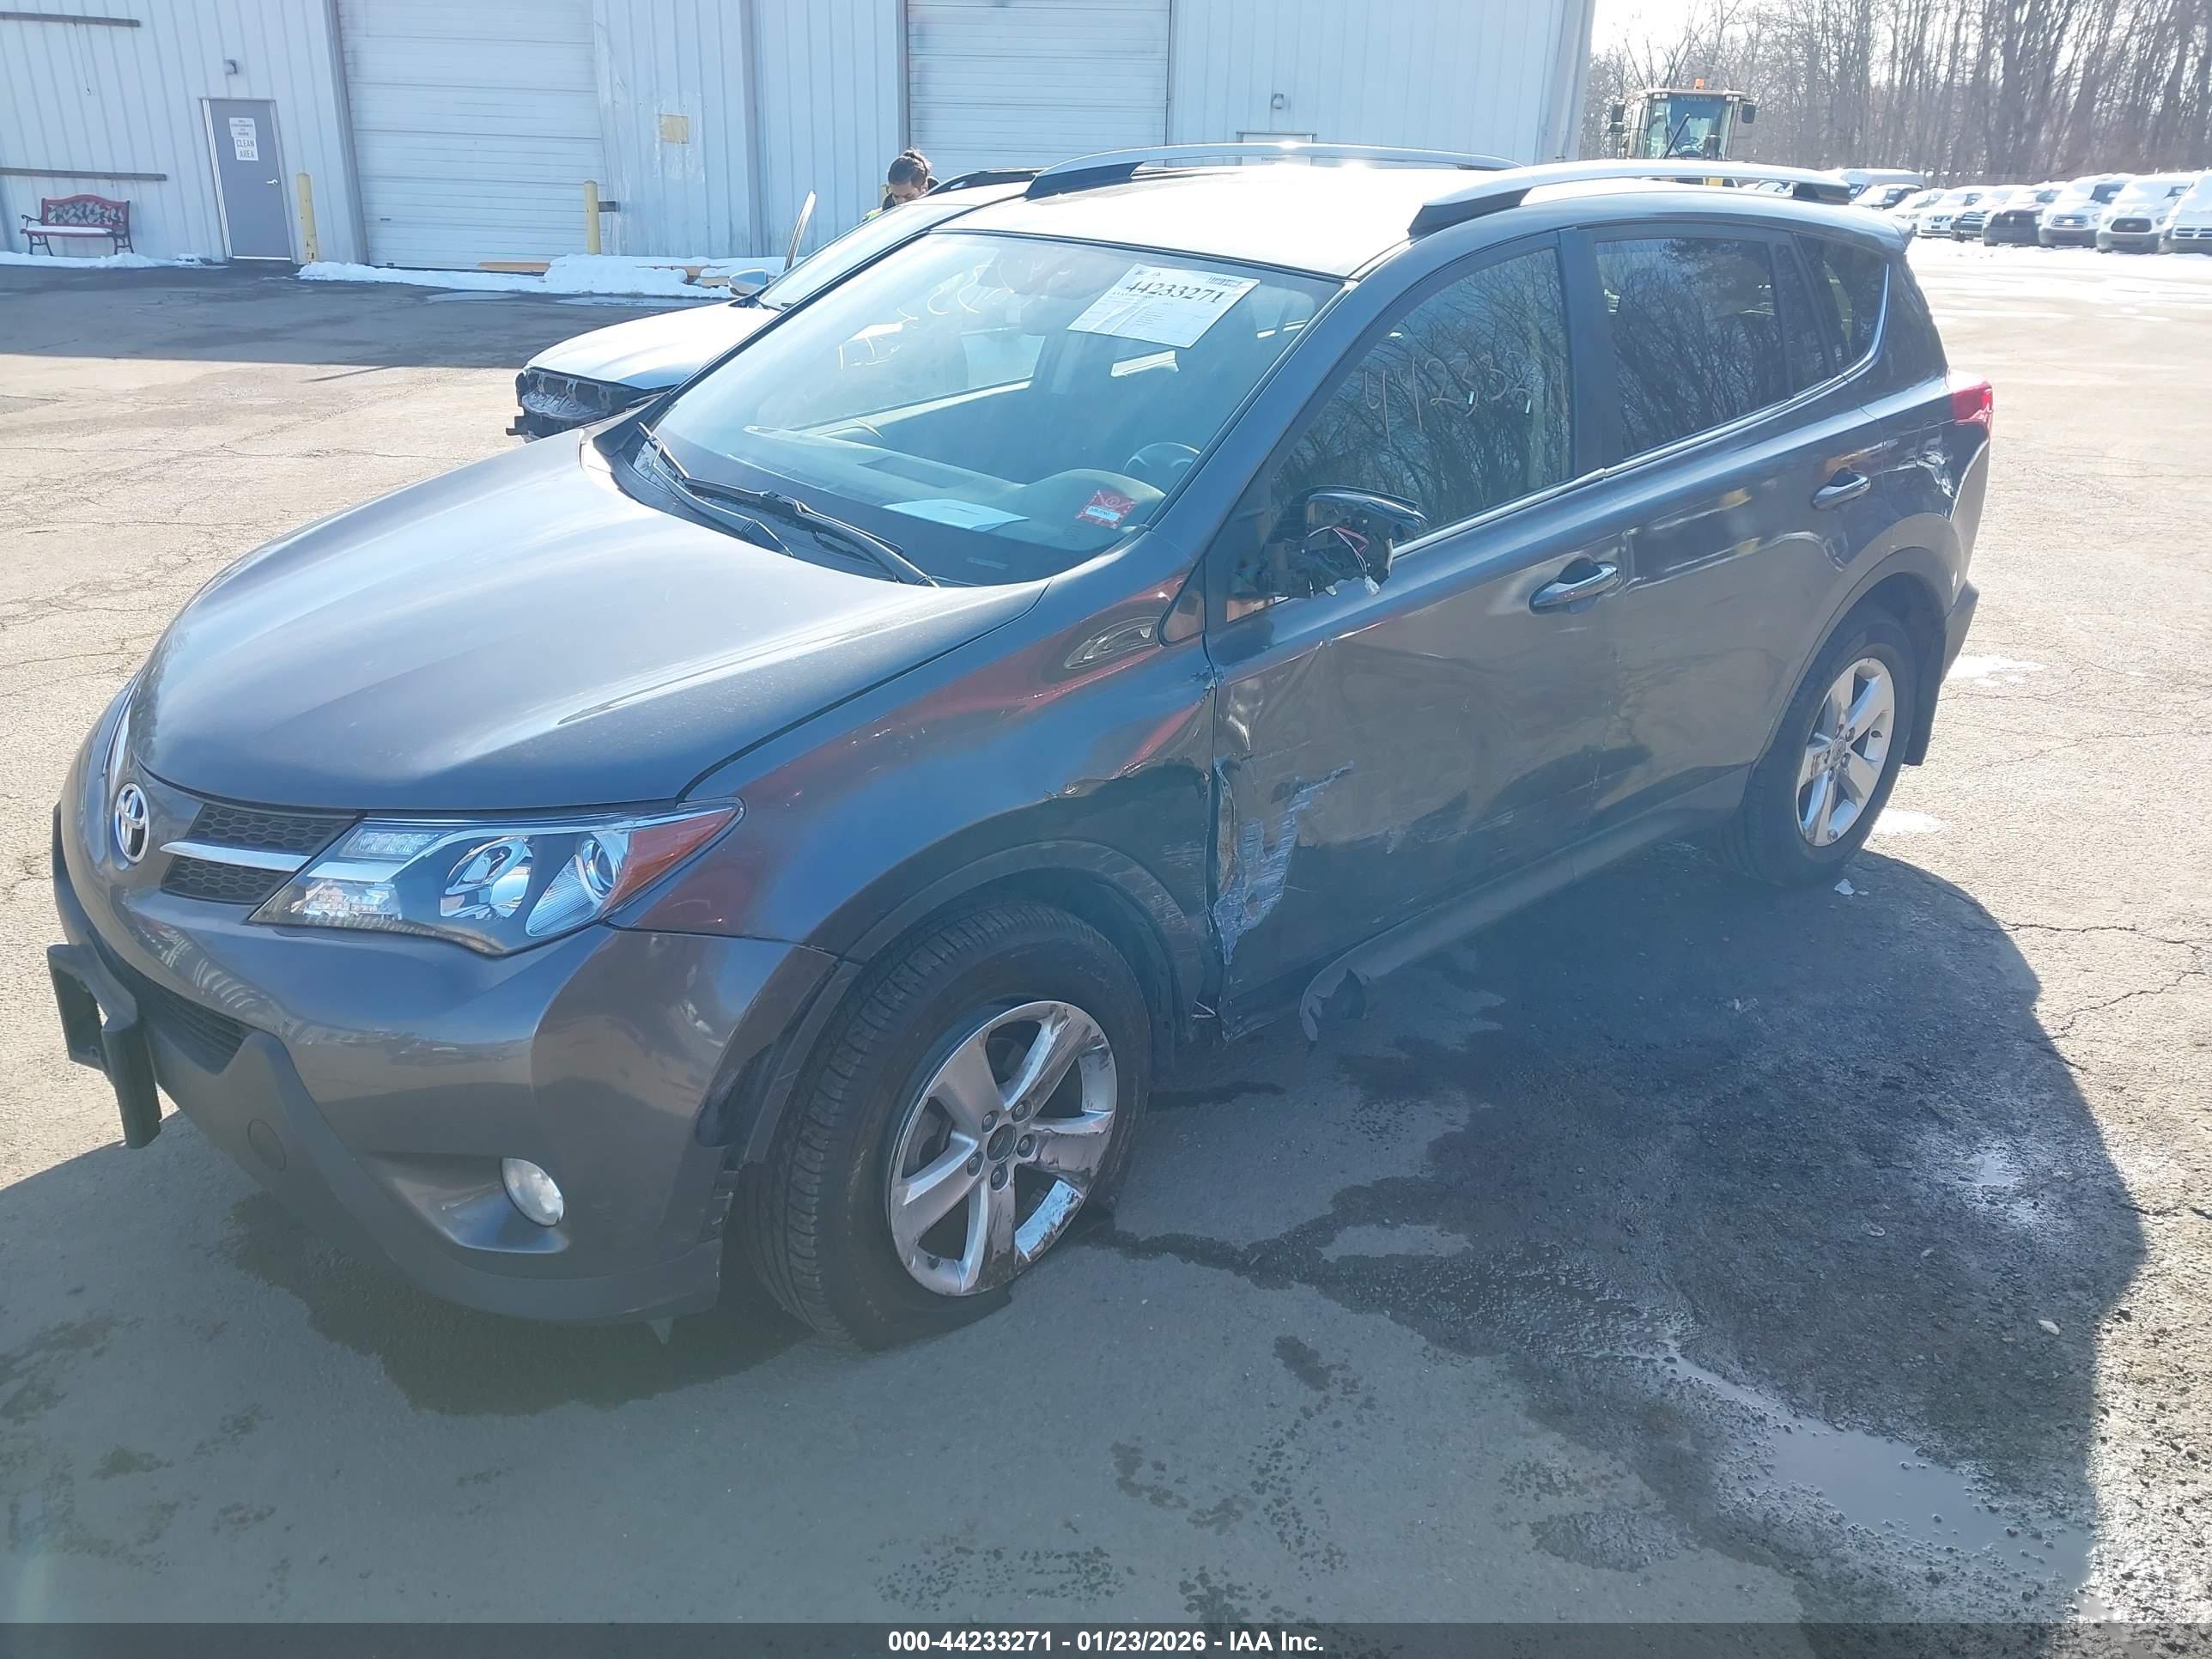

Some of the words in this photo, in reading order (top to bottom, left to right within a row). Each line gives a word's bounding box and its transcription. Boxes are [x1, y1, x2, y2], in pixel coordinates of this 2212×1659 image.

[236, 139, 255, 148] CLEAN
[240, 149, 255, 158] AREA
[1125, 281, 1225, 304] 44233271
